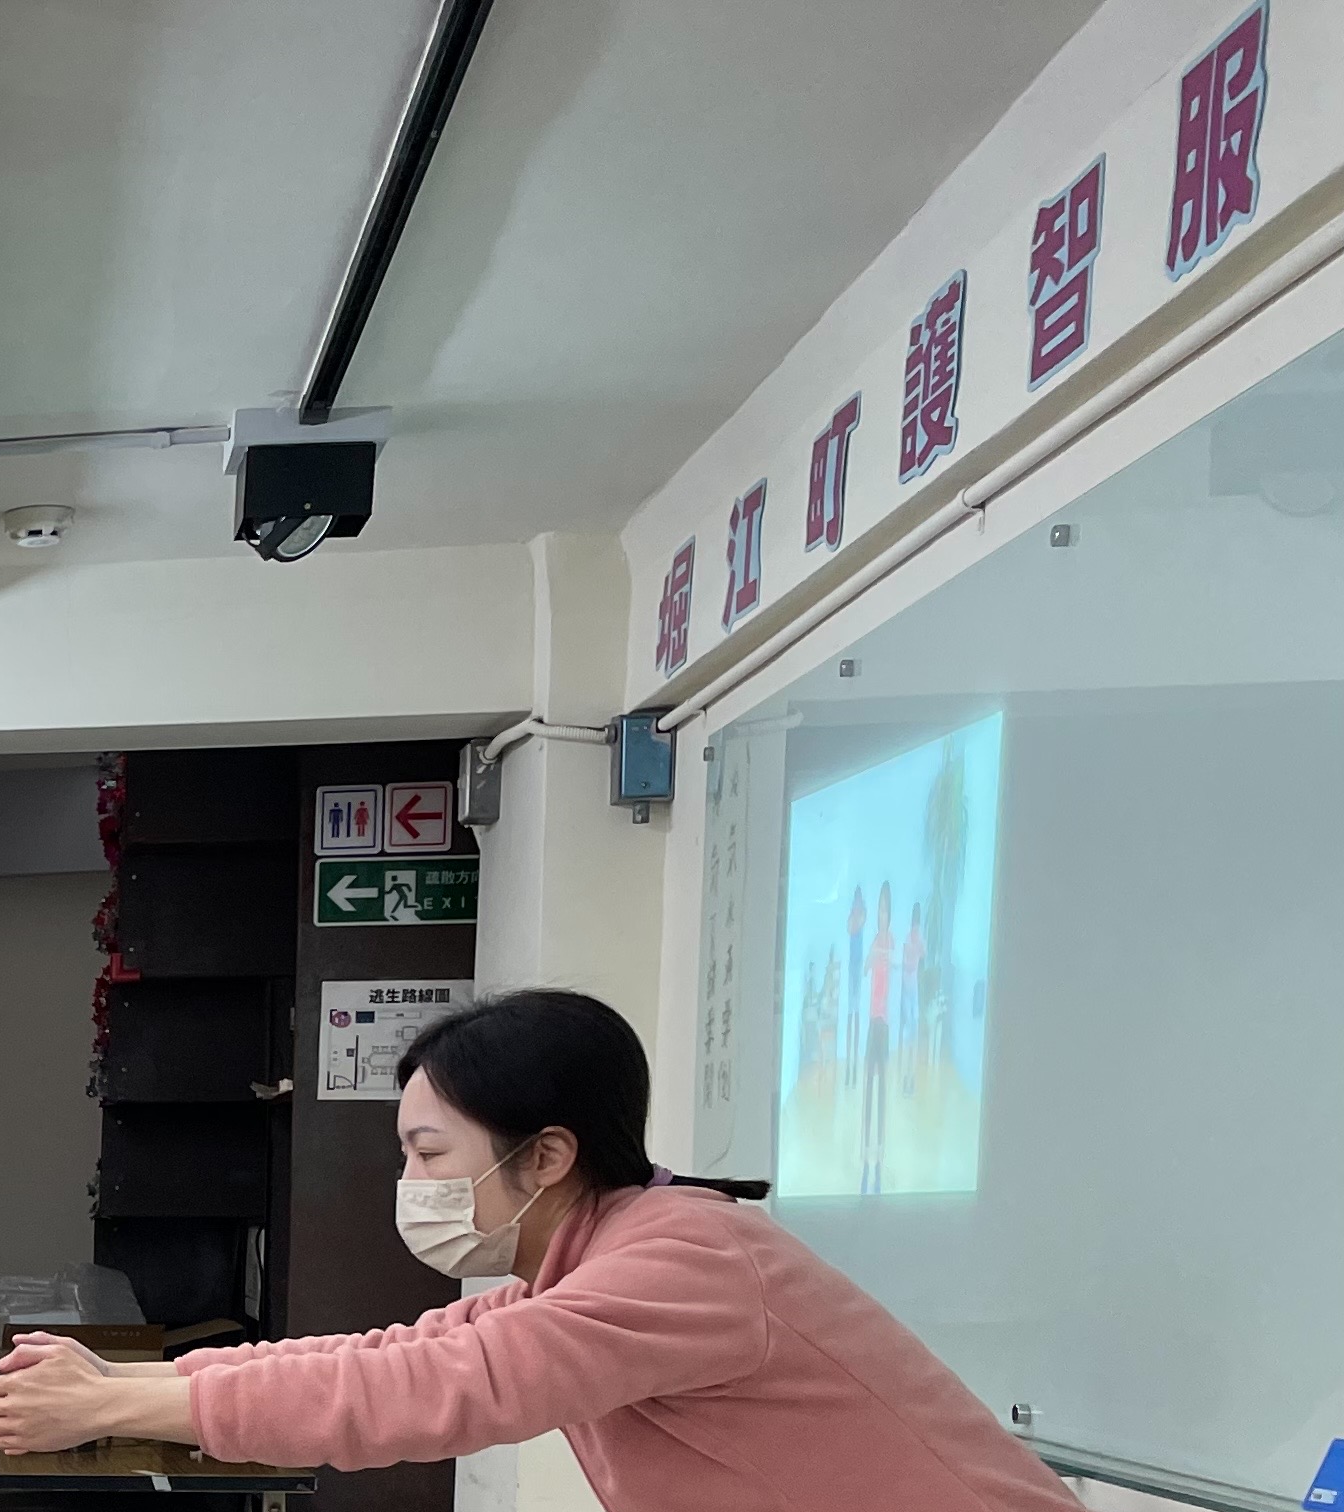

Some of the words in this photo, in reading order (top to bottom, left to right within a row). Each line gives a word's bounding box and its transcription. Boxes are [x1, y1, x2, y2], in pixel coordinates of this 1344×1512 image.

[423, 895, 478, 910] EXI
[368, 988, 450, 1004] 逃生路線圖
